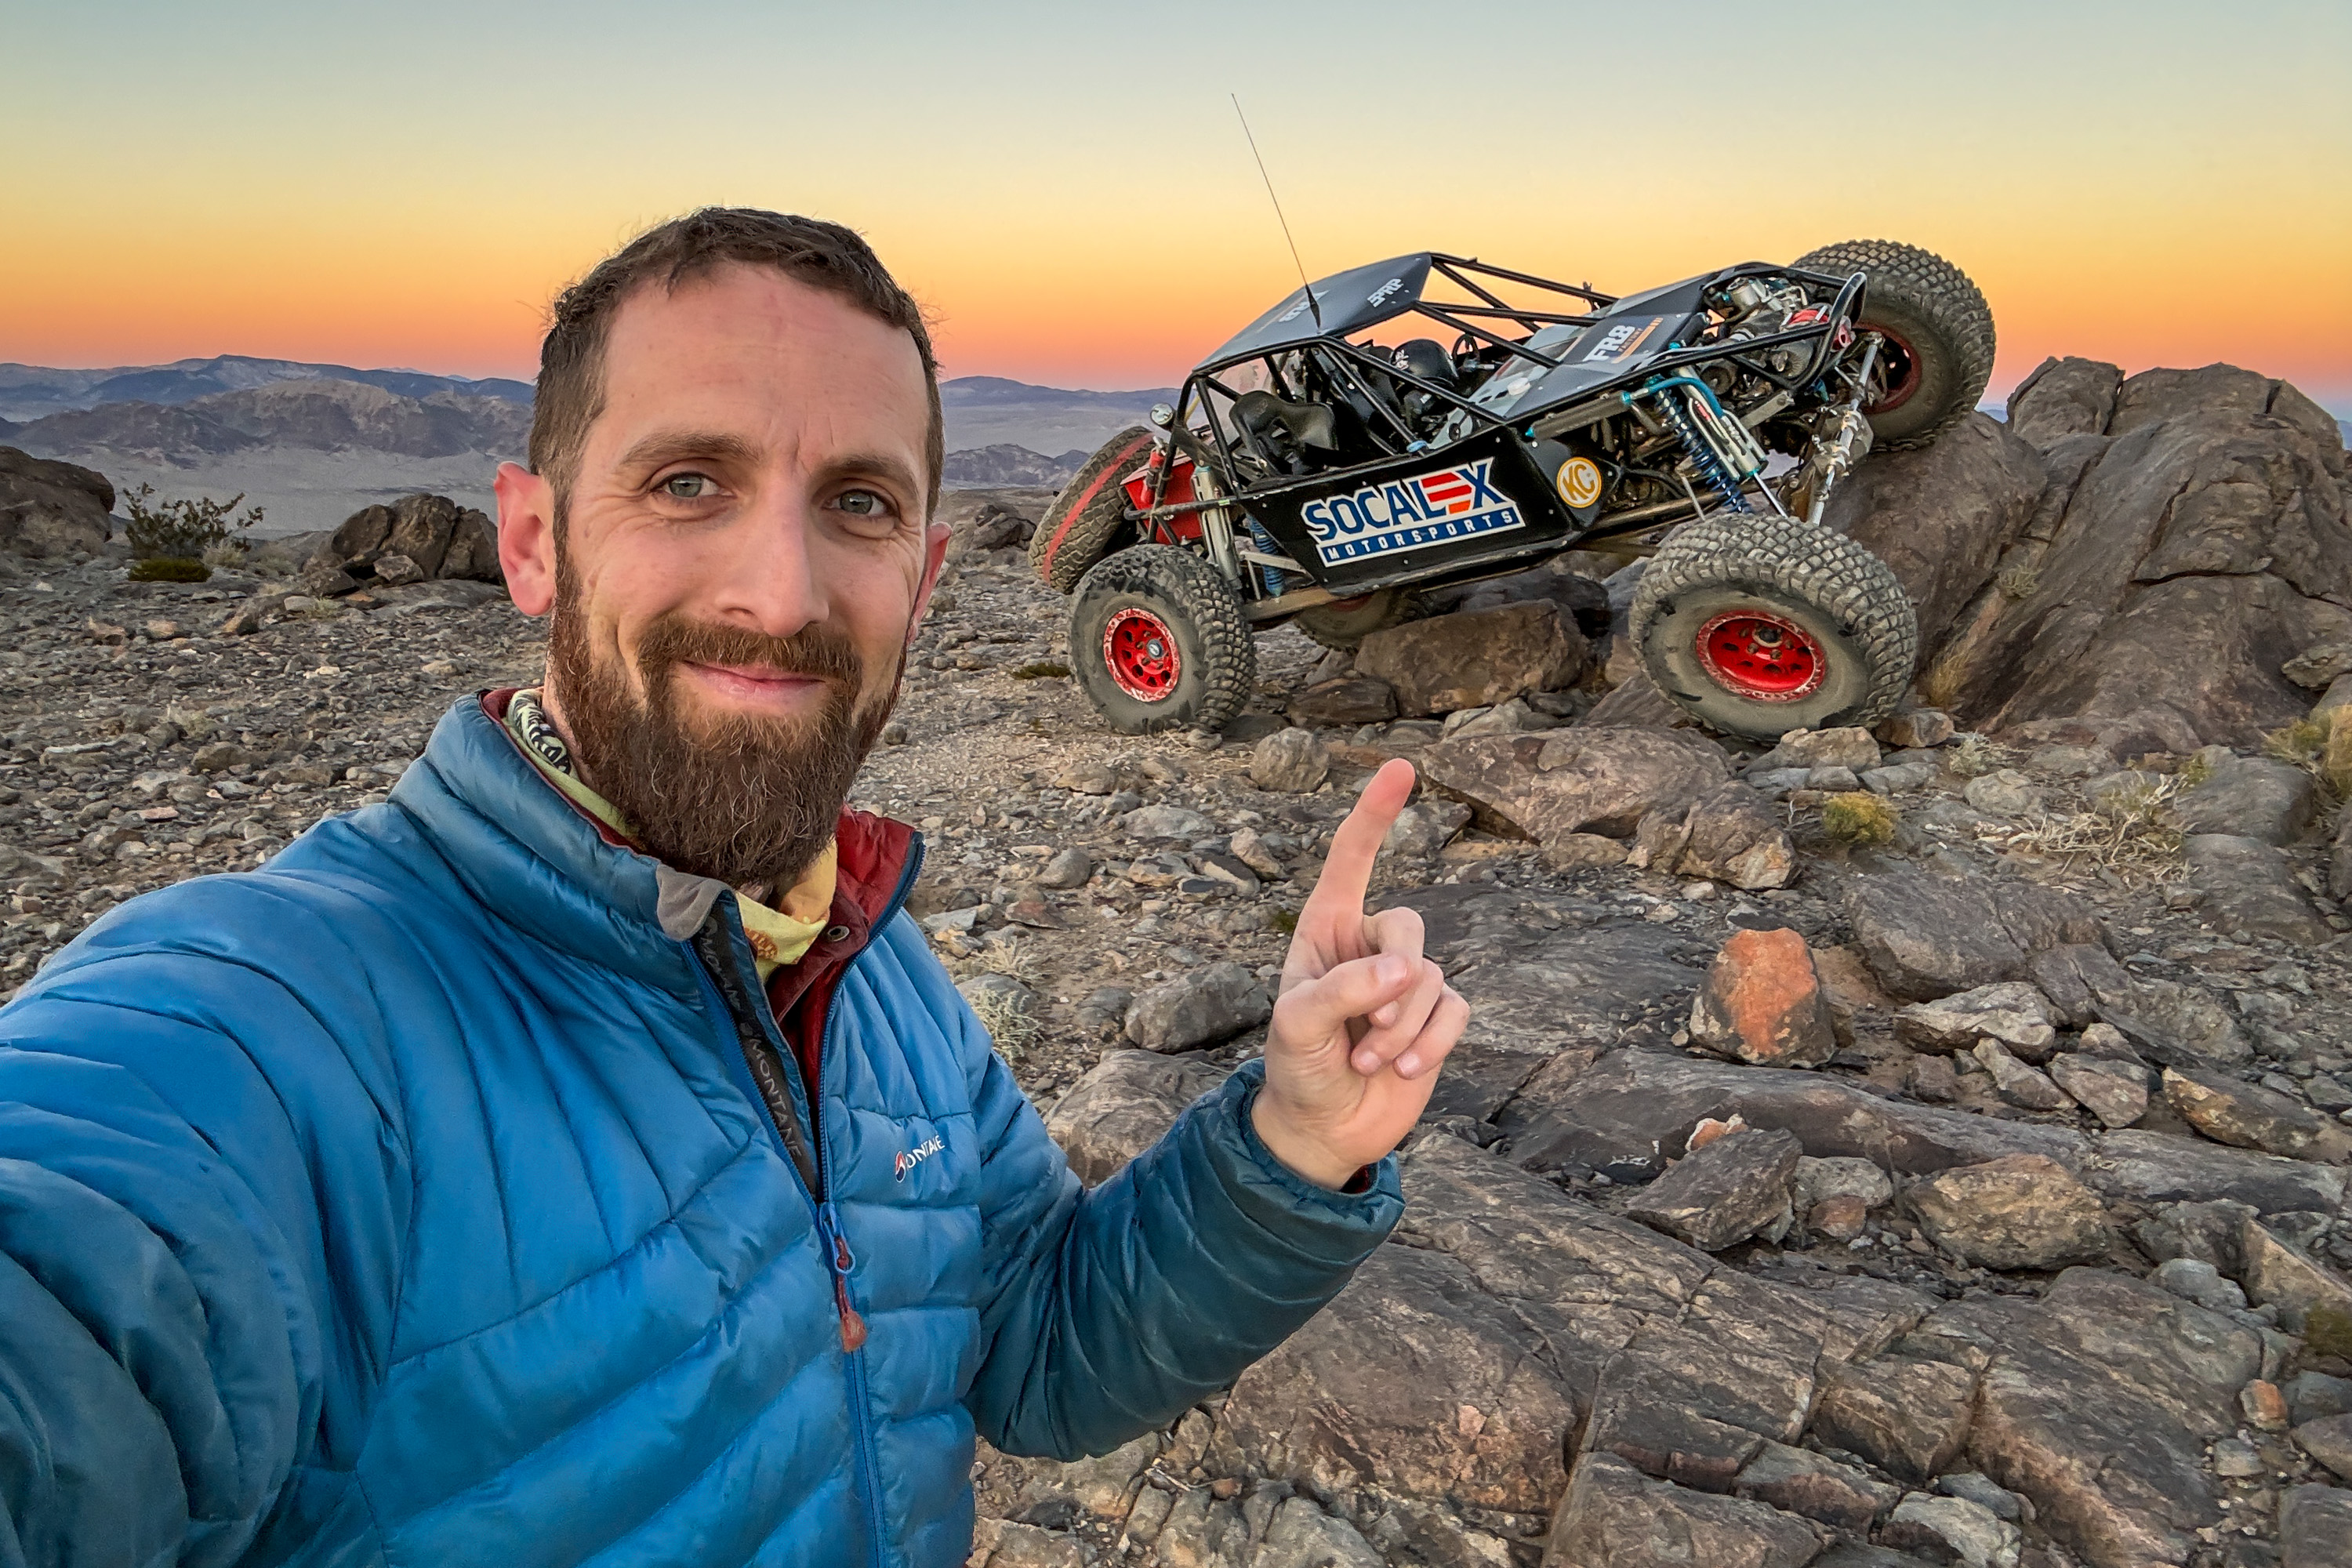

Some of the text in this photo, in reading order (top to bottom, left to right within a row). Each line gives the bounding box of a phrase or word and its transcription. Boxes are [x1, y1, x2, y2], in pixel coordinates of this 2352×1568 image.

[1582, 325, 1635, 361] FR8
[1563, 464, 1595, 501] KC
[1327, 510, 1513, 560] MOTORSPORTS
[749, 1038, 803, 1157] MONTANE
